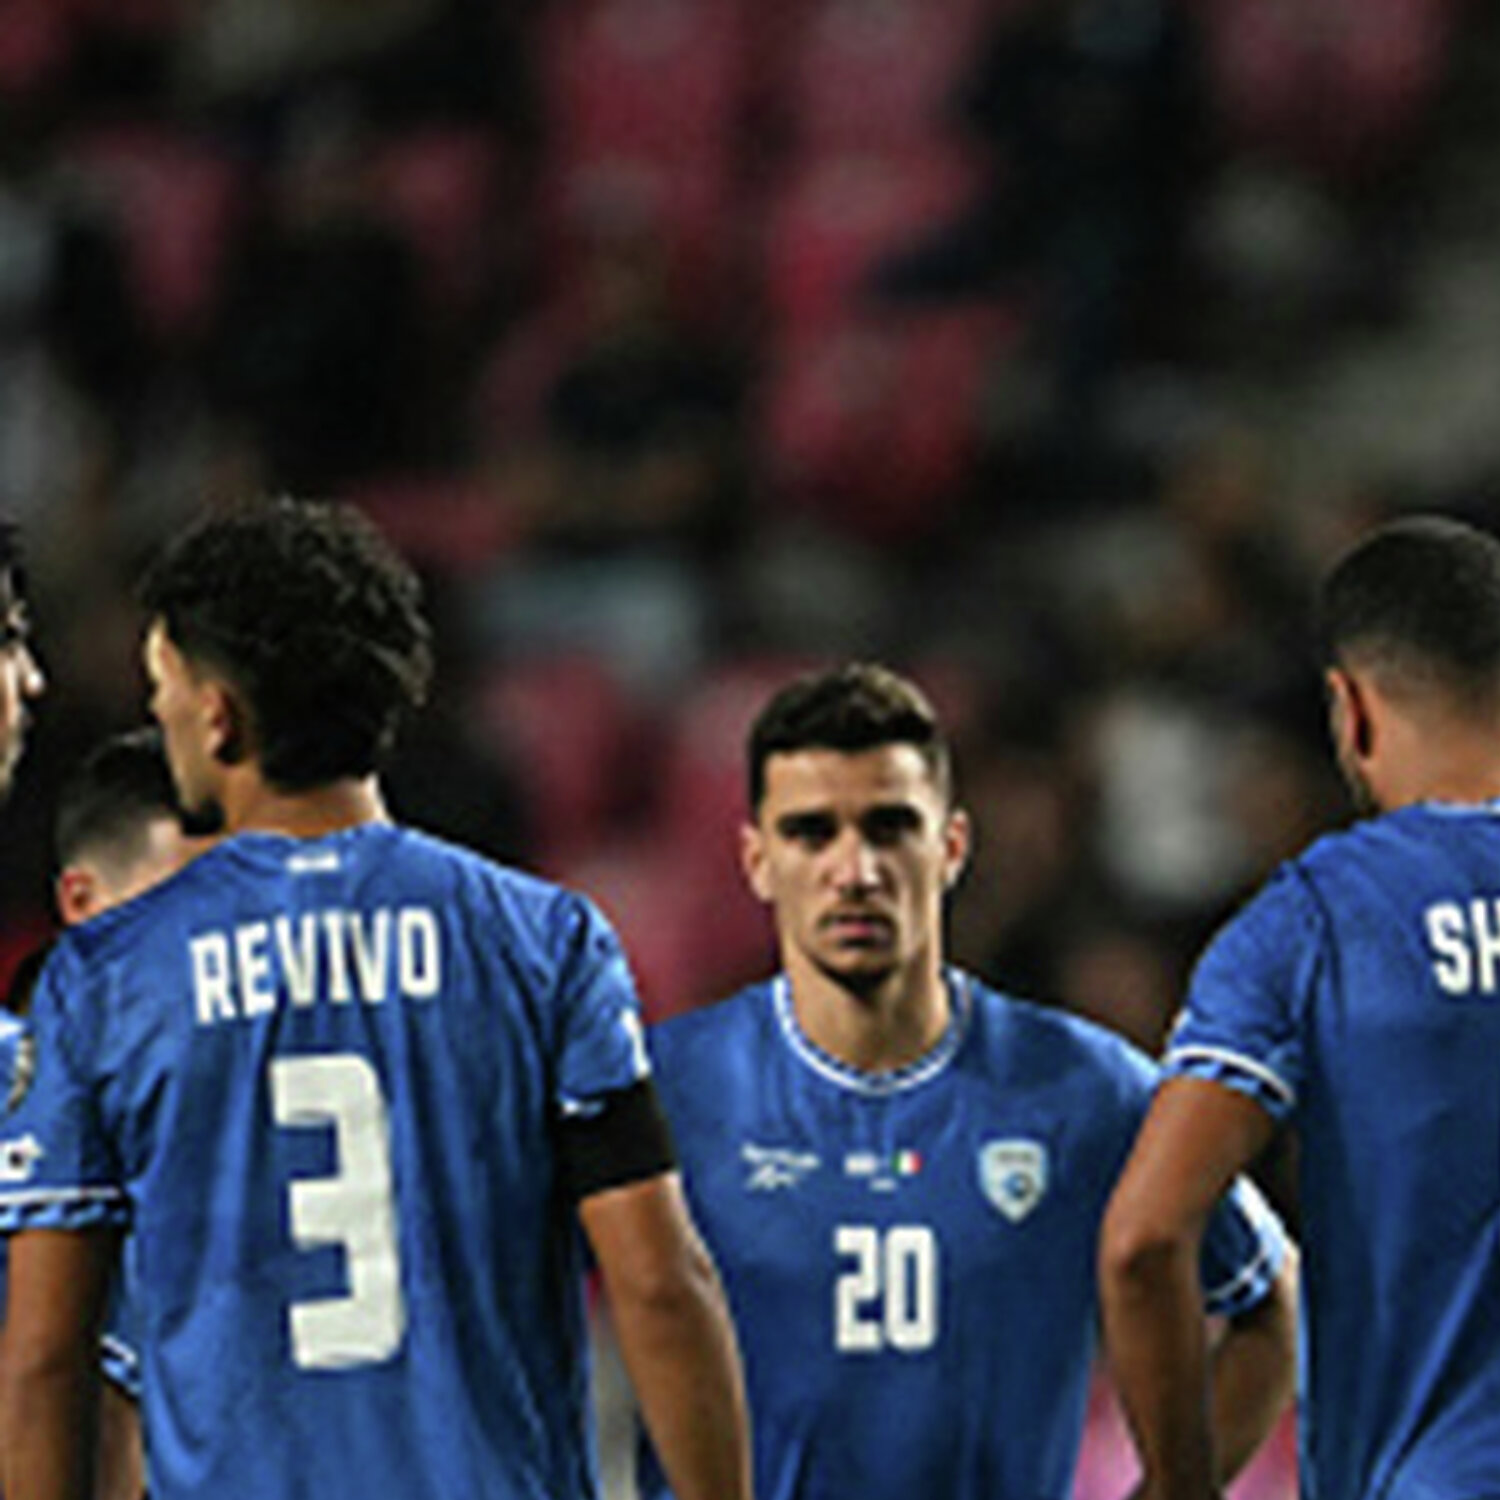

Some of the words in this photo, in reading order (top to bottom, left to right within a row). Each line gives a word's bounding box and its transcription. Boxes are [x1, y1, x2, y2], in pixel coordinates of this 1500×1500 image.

[188, 907, 441, 1025] REVIVO
[268, 1052, 405, 1369] 3
[834, 1225, 937, 1351] 20
